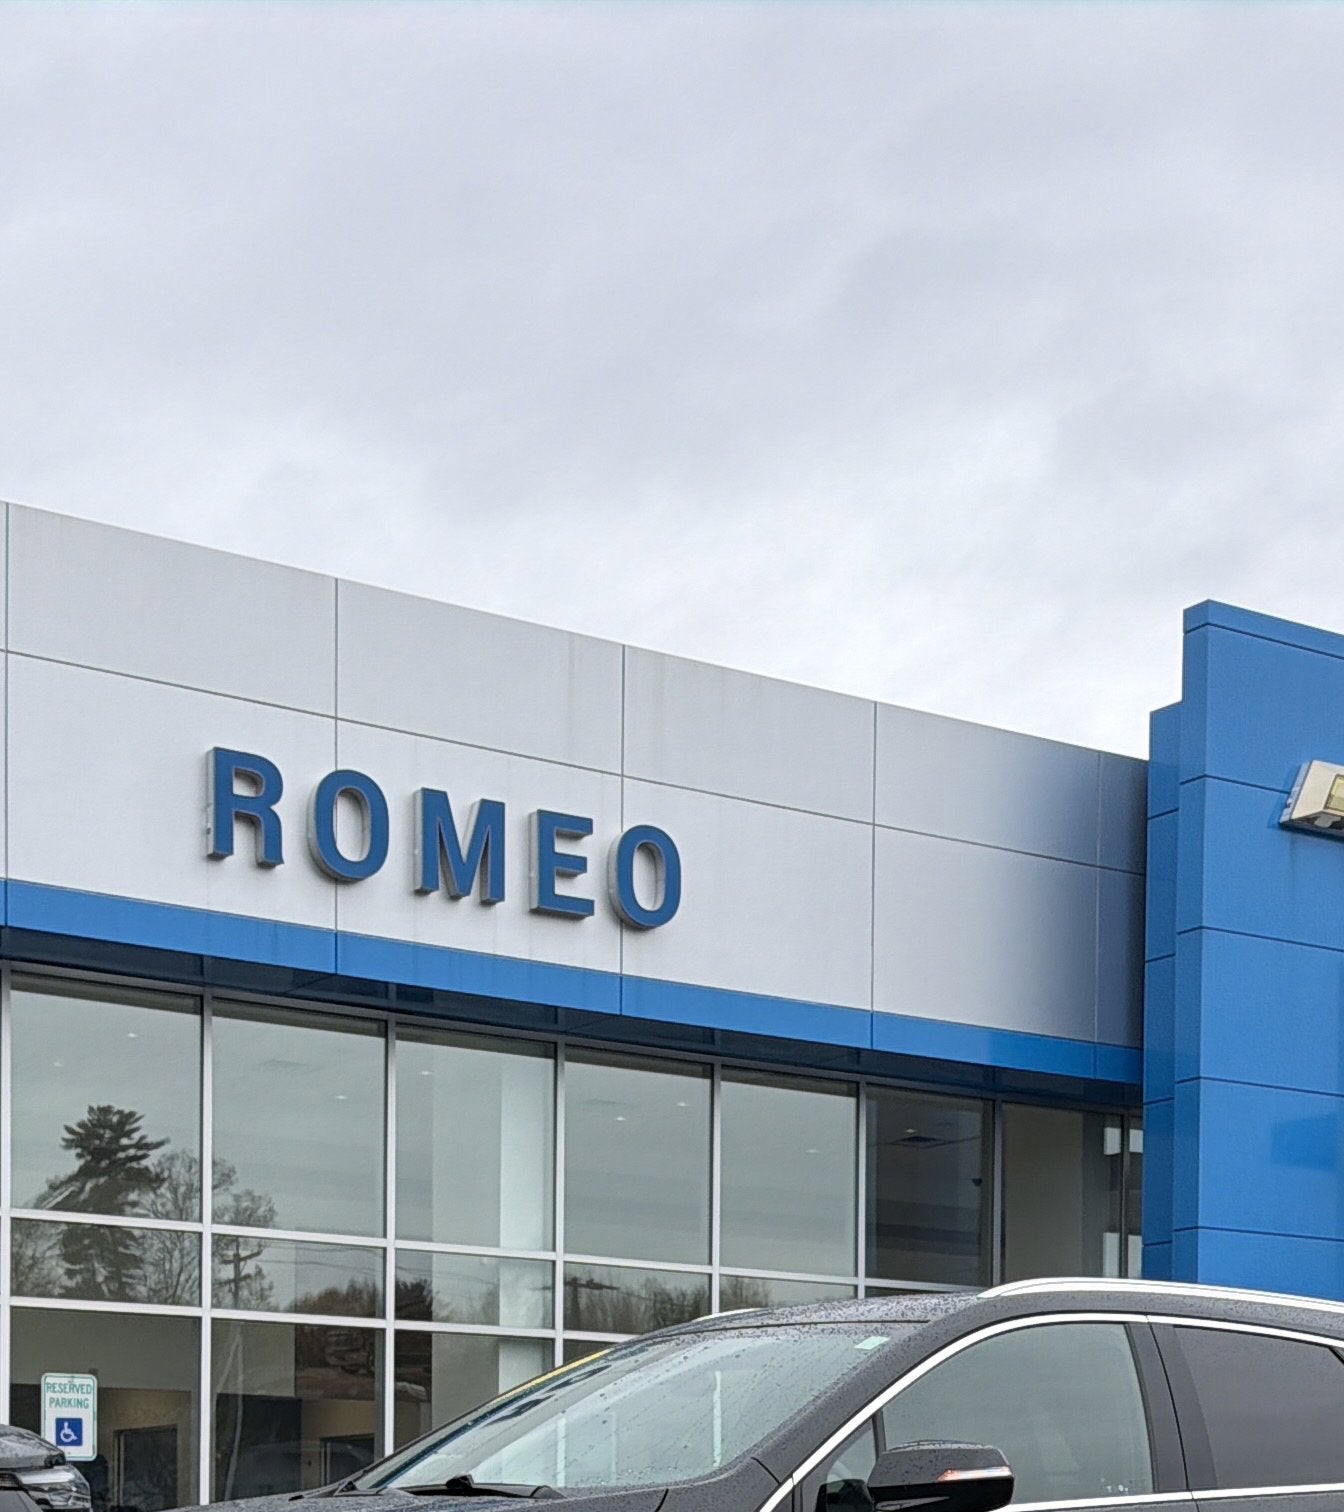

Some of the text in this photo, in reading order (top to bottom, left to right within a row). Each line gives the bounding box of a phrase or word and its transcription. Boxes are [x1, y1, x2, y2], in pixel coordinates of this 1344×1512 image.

[206, 746, 682, 930] ROMEO
[46, 1382, 93, 1395] RESERVED
[49, 1397, 89, 1409] PARKING
